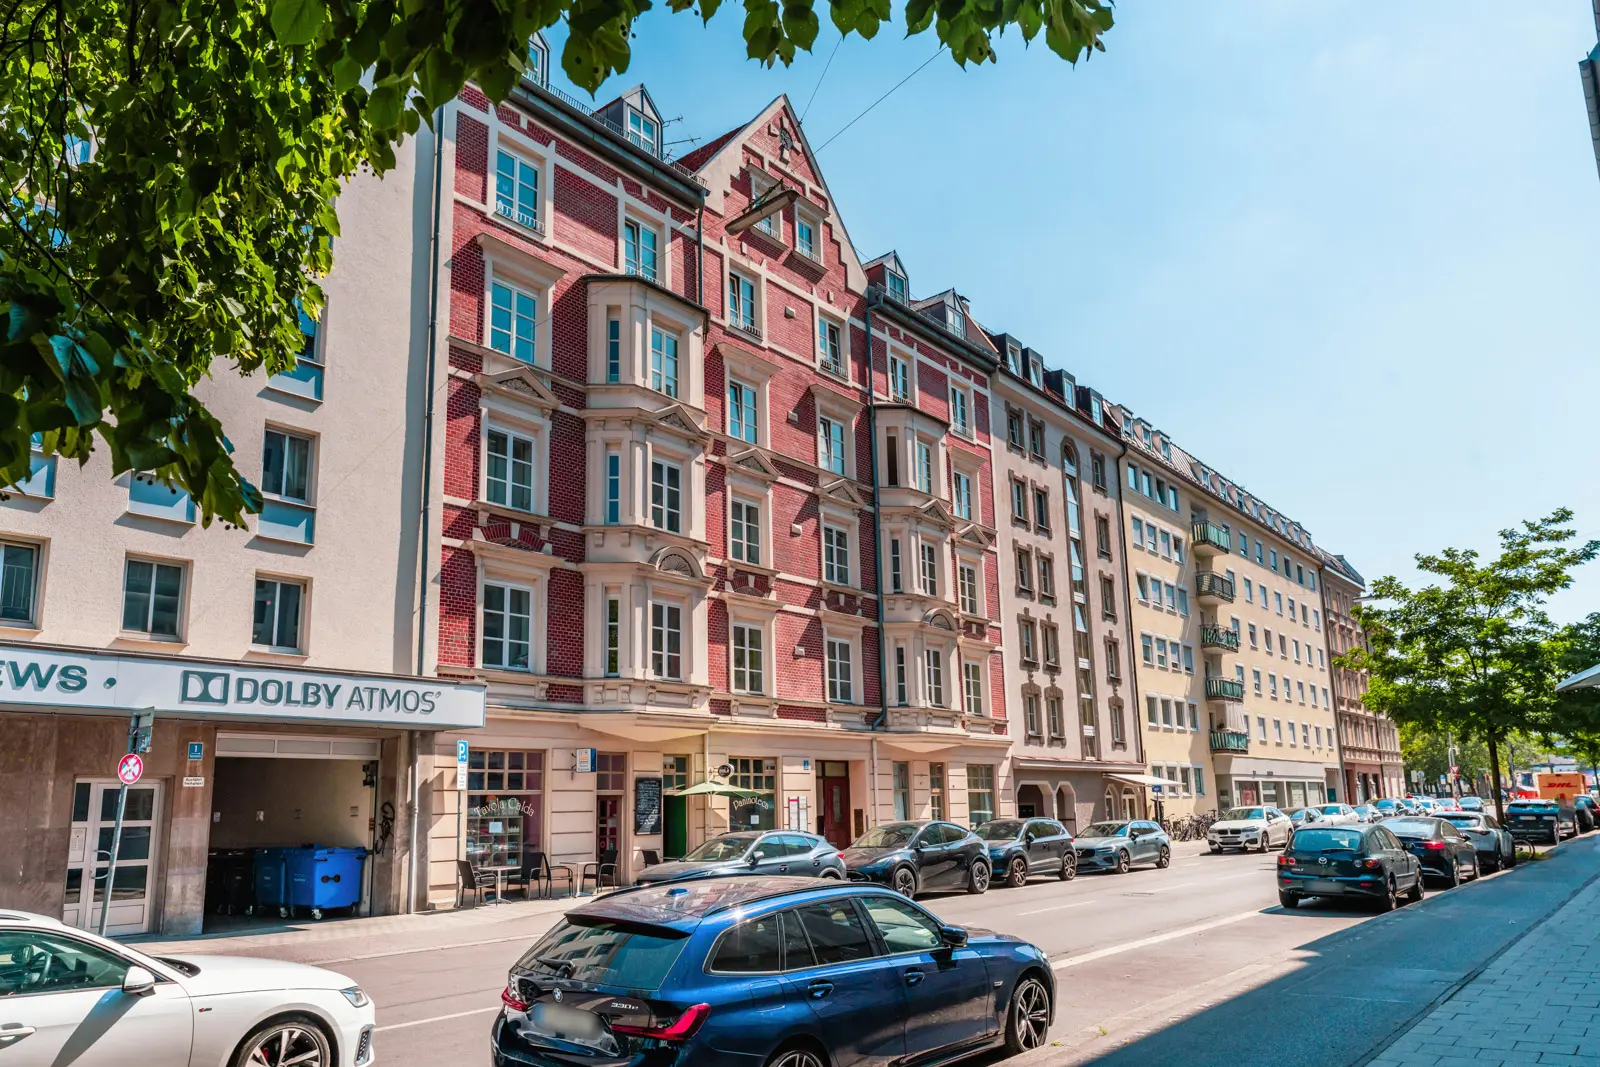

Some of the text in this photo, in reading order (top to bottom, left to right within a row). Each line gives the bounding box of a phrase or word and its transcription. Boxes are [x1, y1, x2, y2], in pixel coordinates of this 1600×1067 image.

[0, 660, 88, 692] WS
[236, 677, 342, 709] DOLBY
[473, 797, 535, 818] Tavola Calda
